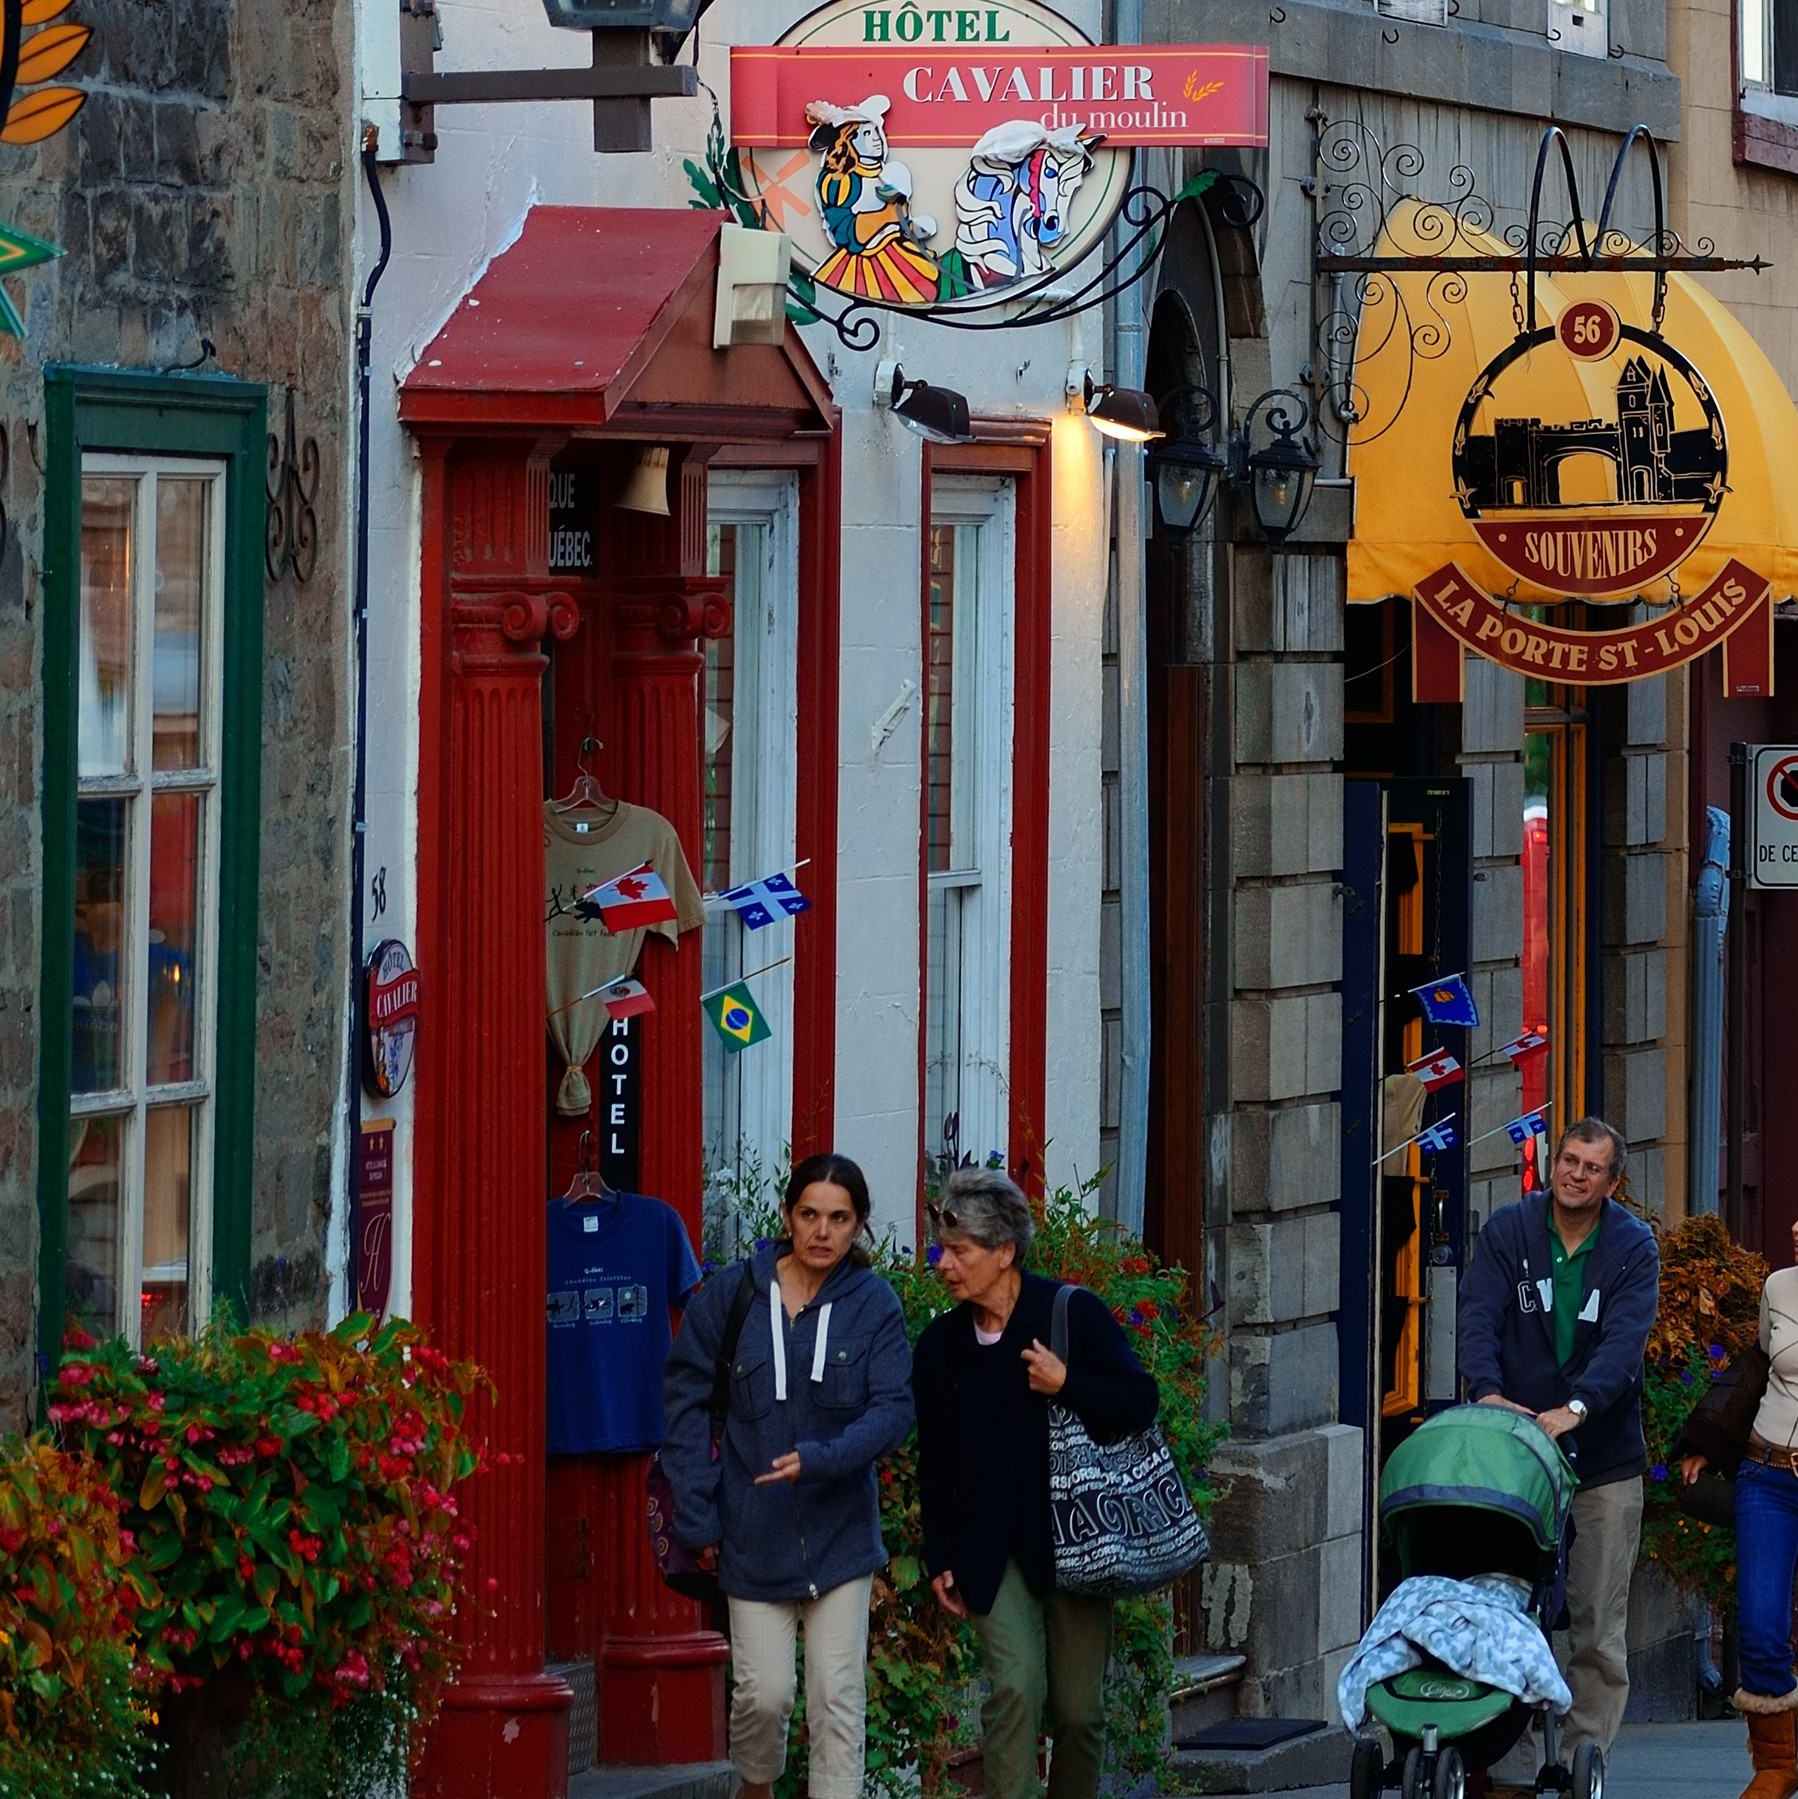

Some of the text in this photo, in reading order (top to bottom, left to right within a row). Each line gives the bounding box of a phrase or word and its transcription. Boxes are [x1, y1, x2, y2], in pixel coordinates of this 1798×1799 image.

[863, 1, 1010, 42] HÔTEL
[903, 66, 1155, 103] CAVALIER
[1040, 101, 1188, 129] du moulin
[1573, 315, 1602, 344] 56
[1524, 528, 1657, 580] SOUVENIRS
[1433, 580, 1477, 628] LA
[1475, 614, 1588, 672] PORTE
[1760, 845, 1776, 862] DE
[1782, 845, 1798, 862] CE
[371, 866, 386, 922] 58
[383, 952, 404, 980] HÔTEL
[376, 981, 417, 1018] CAVALIER
[611, 1017, 629, 1154] HOTEL
